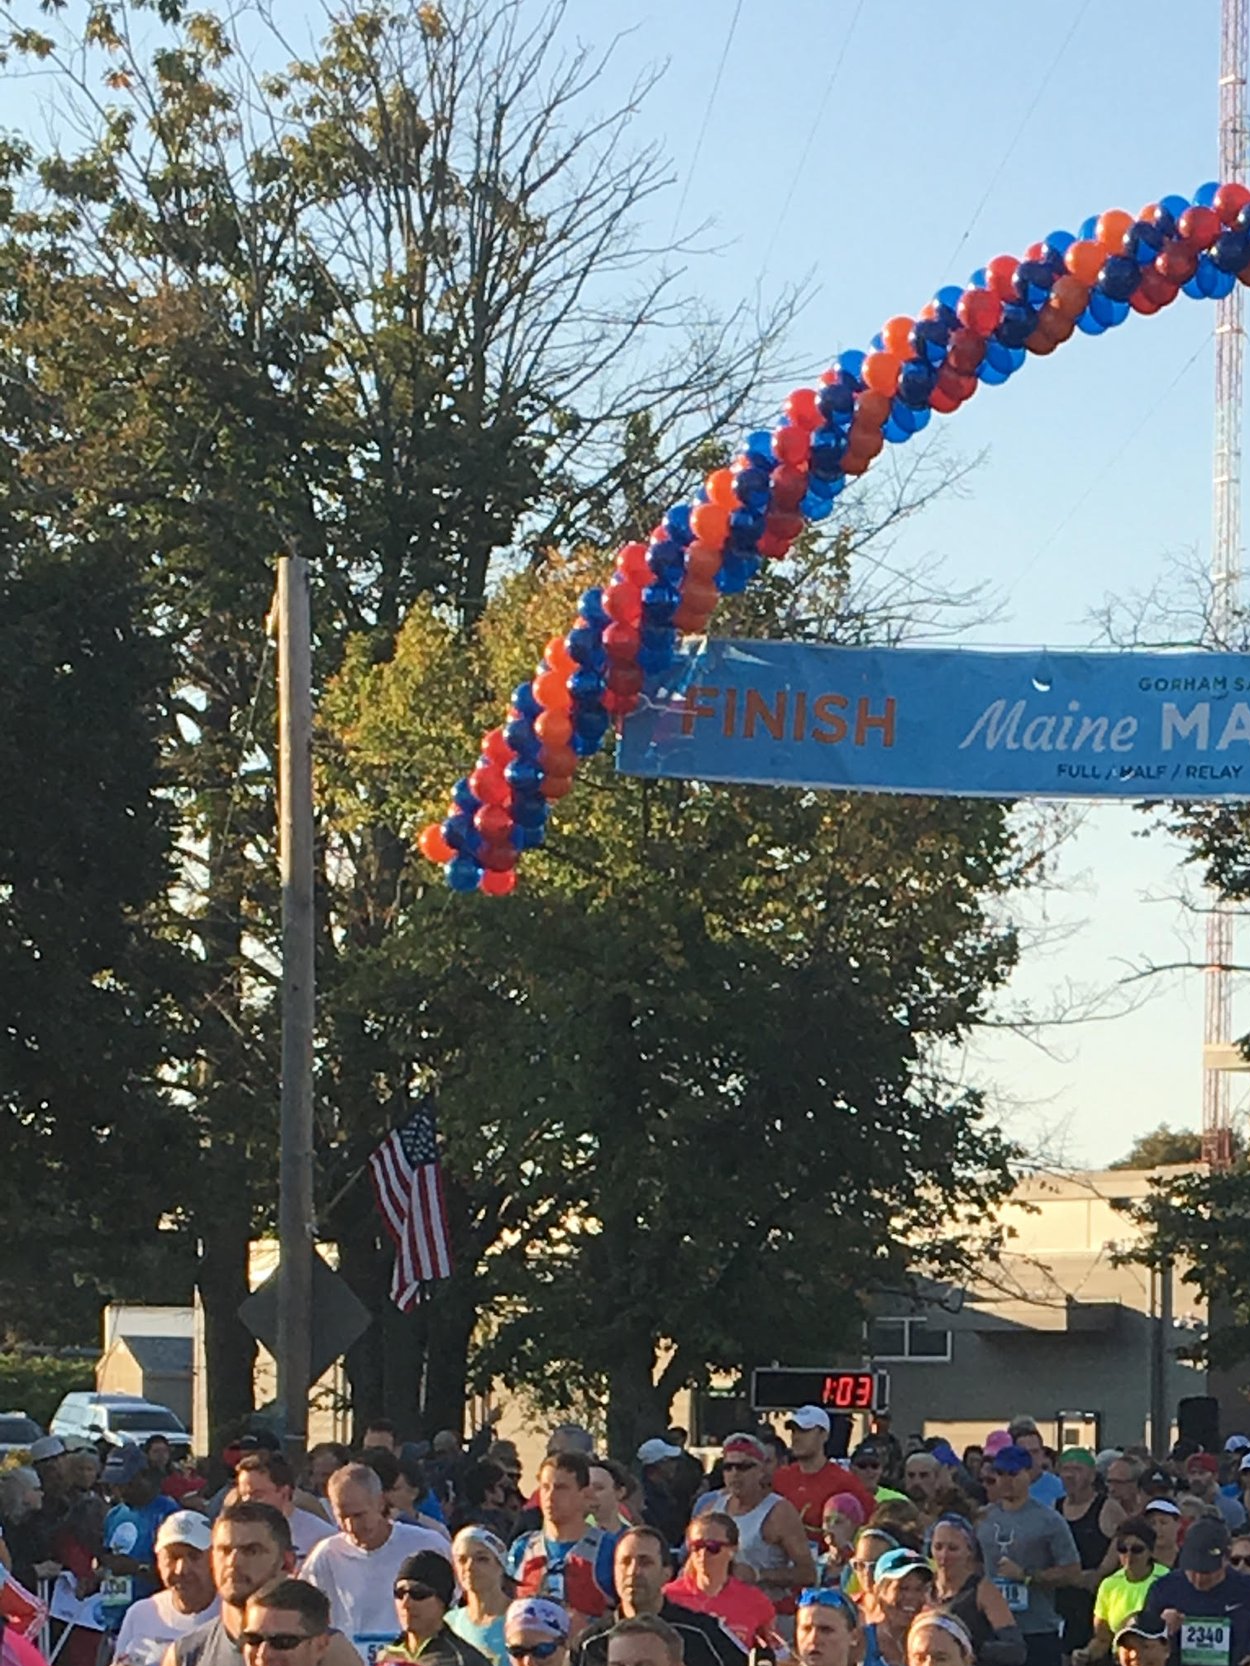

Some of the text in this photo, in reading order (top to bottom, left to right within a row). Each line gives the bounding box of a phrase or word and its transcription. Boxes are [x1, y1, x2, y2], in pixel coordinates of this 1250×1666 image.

[1138, 676, 1227, 692] GORHAM
[681, 684, 897, 747] FINISH
[958, 699, 1139, 751] Maine
[1057, 763, 1099, 779] FULL
[1119, 764, 1168, 780] HALF
[1185, 764, 1244, 779] RELAY
[822, 1376, 873, 1406] 1:03
